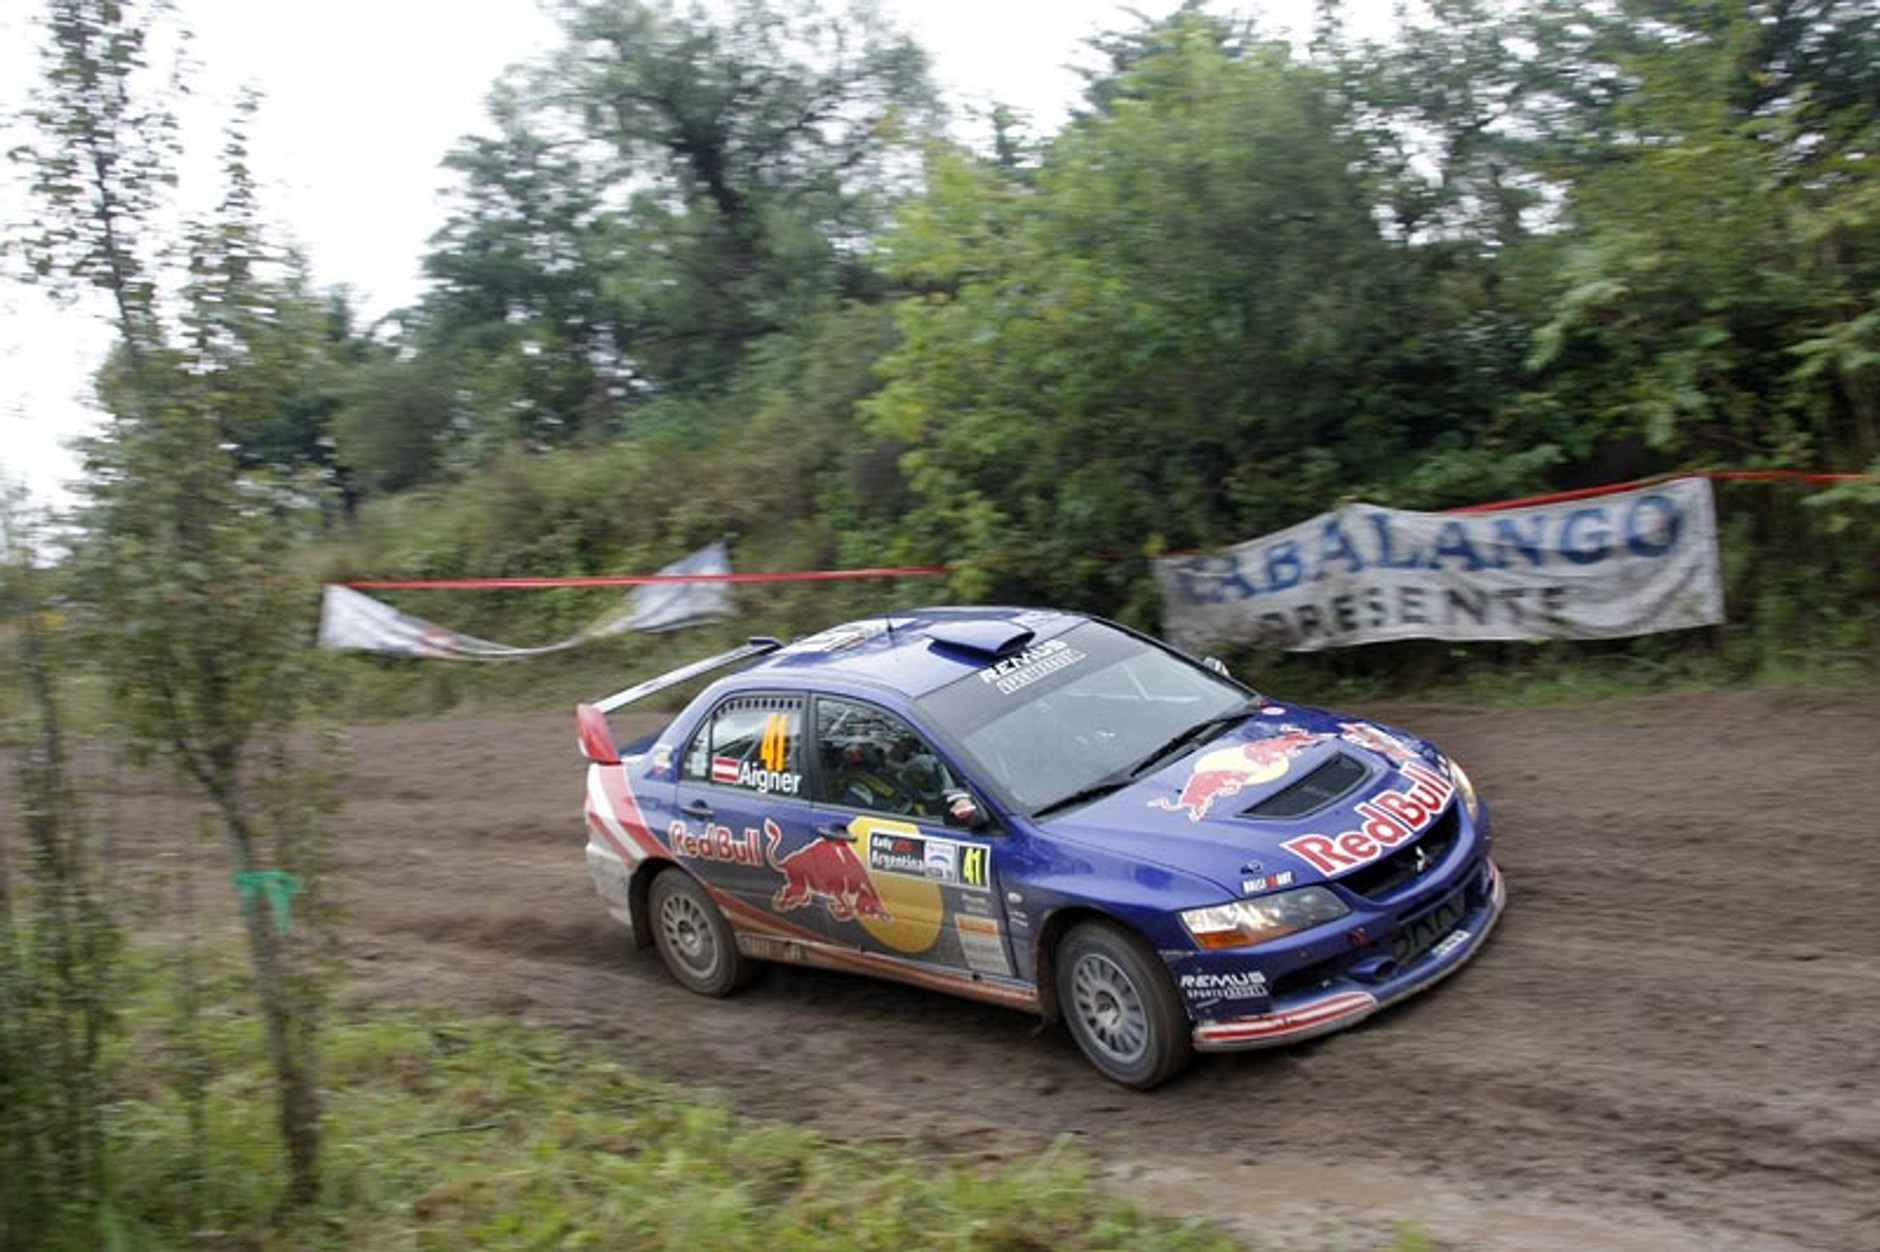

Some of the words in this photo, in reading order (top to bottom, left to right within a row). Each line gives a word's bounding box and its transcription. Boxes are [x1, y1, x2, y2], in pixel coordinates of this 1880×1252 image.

[979, 640, 1068, 685] REMUS
[761, 712, 788, 772] 41
[739, 761, 802, 793] Aigner
[871, 849, 926, 872] Argentina
[964, 847, 982, 885] 41
[1181, 971, 1267, 988] REMUS
